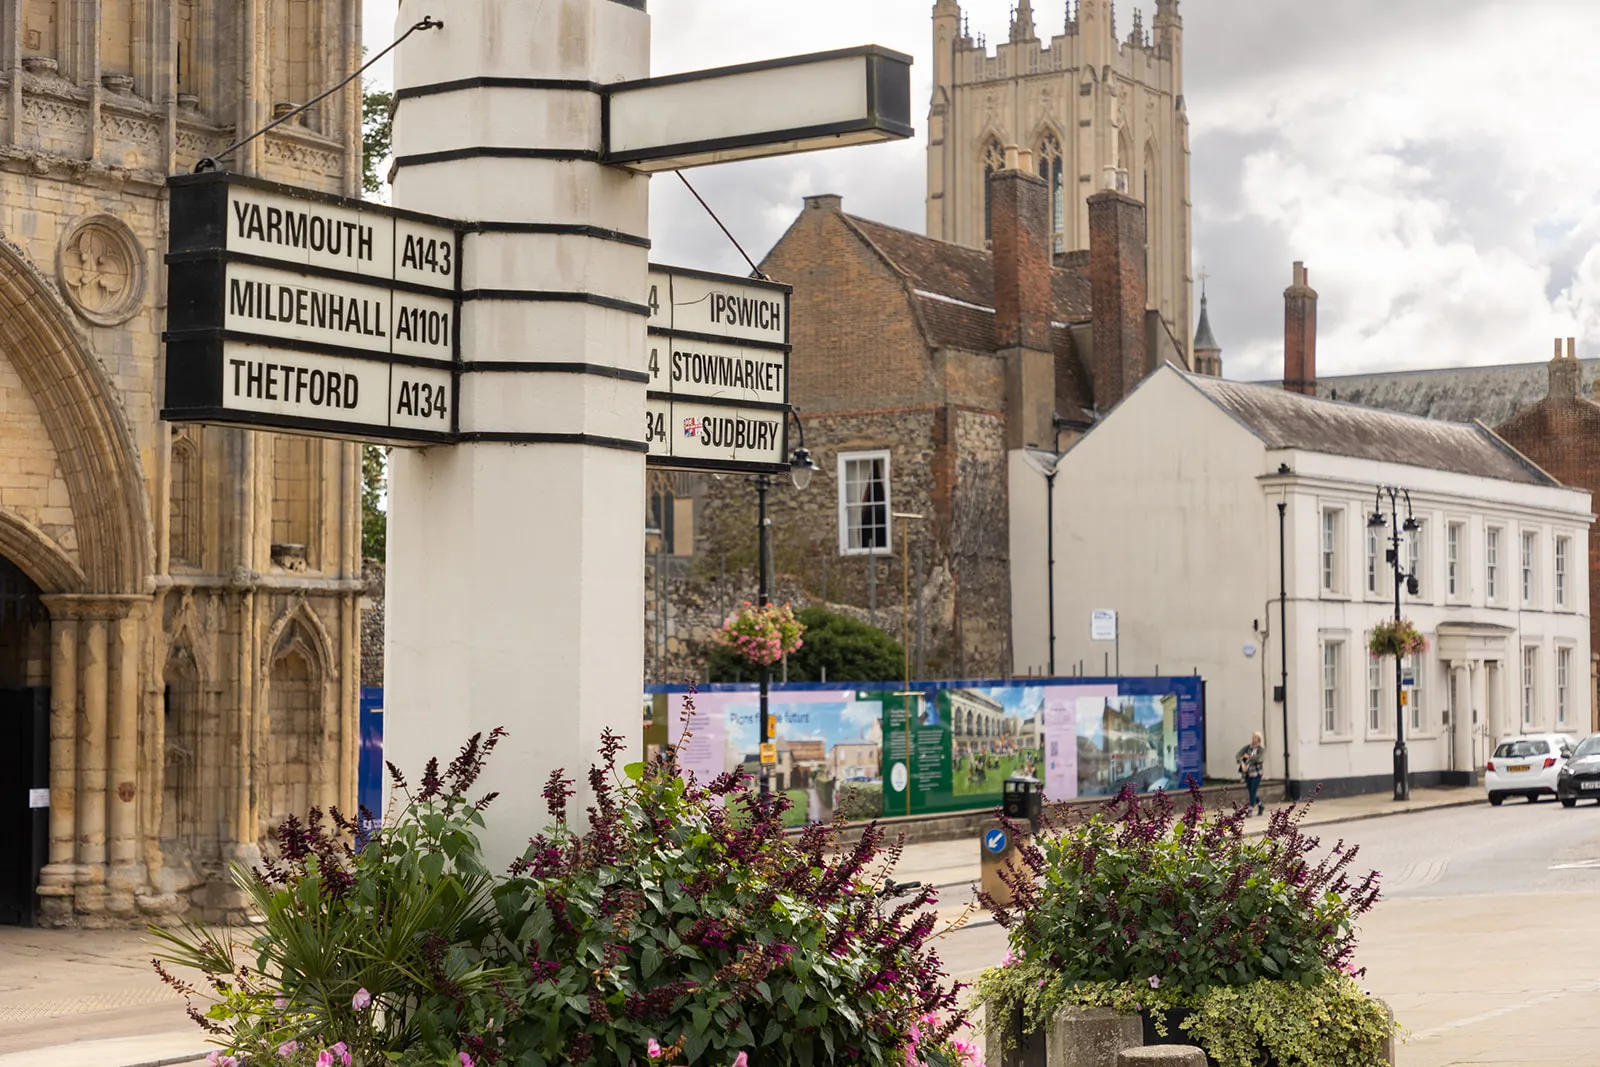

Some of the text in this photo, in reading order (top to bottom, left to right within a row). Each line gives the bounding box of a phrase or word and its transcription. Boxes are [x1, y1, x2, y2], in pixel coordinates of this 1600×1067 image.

[233, 200, 451, 275] YARMOUTH A143
[230, 278, 449, 346] MILDENHALL A1101
[648, 285, 780, 331] 4 IPSWICH
[229, 358, 447, 419] THETFORD A134
[648, 348, 782, 392] 4 STOWMARKET
[645, 411, 779, 450] 34 SUDBURY
